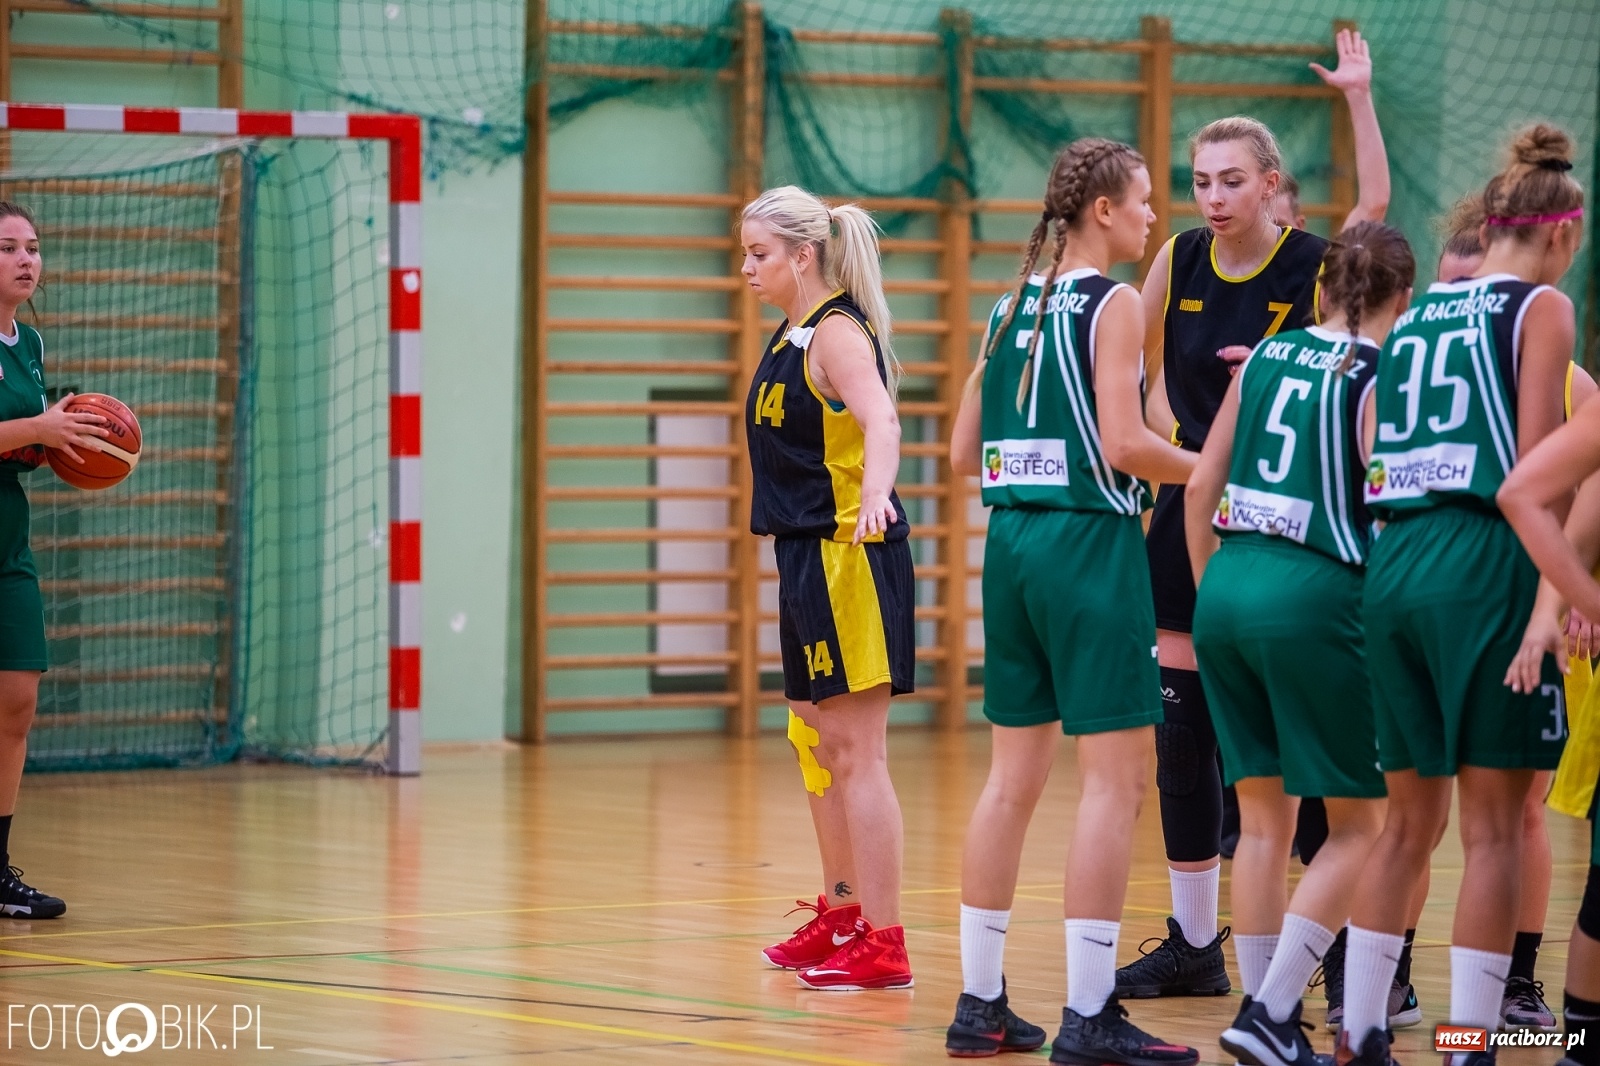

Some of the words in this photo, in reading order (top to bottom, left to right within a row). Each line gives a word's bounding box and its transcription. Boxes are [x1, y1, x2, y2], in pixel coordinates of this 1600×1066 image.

[1263, 301, 1293, 338] 7
[1015, 329, 1045, 429] 7
[1261, 341, 1296, 361] RKK
[1295, 346, 1368, 380] RACIBOZ
[1378, 327, 1480, 442] 35
[754, 381, 785, 428] 14
[1257, 375, 1313, 483] 5
[803, 640, 834, 681] 14
[1541, 684, 1568, 741] 3
